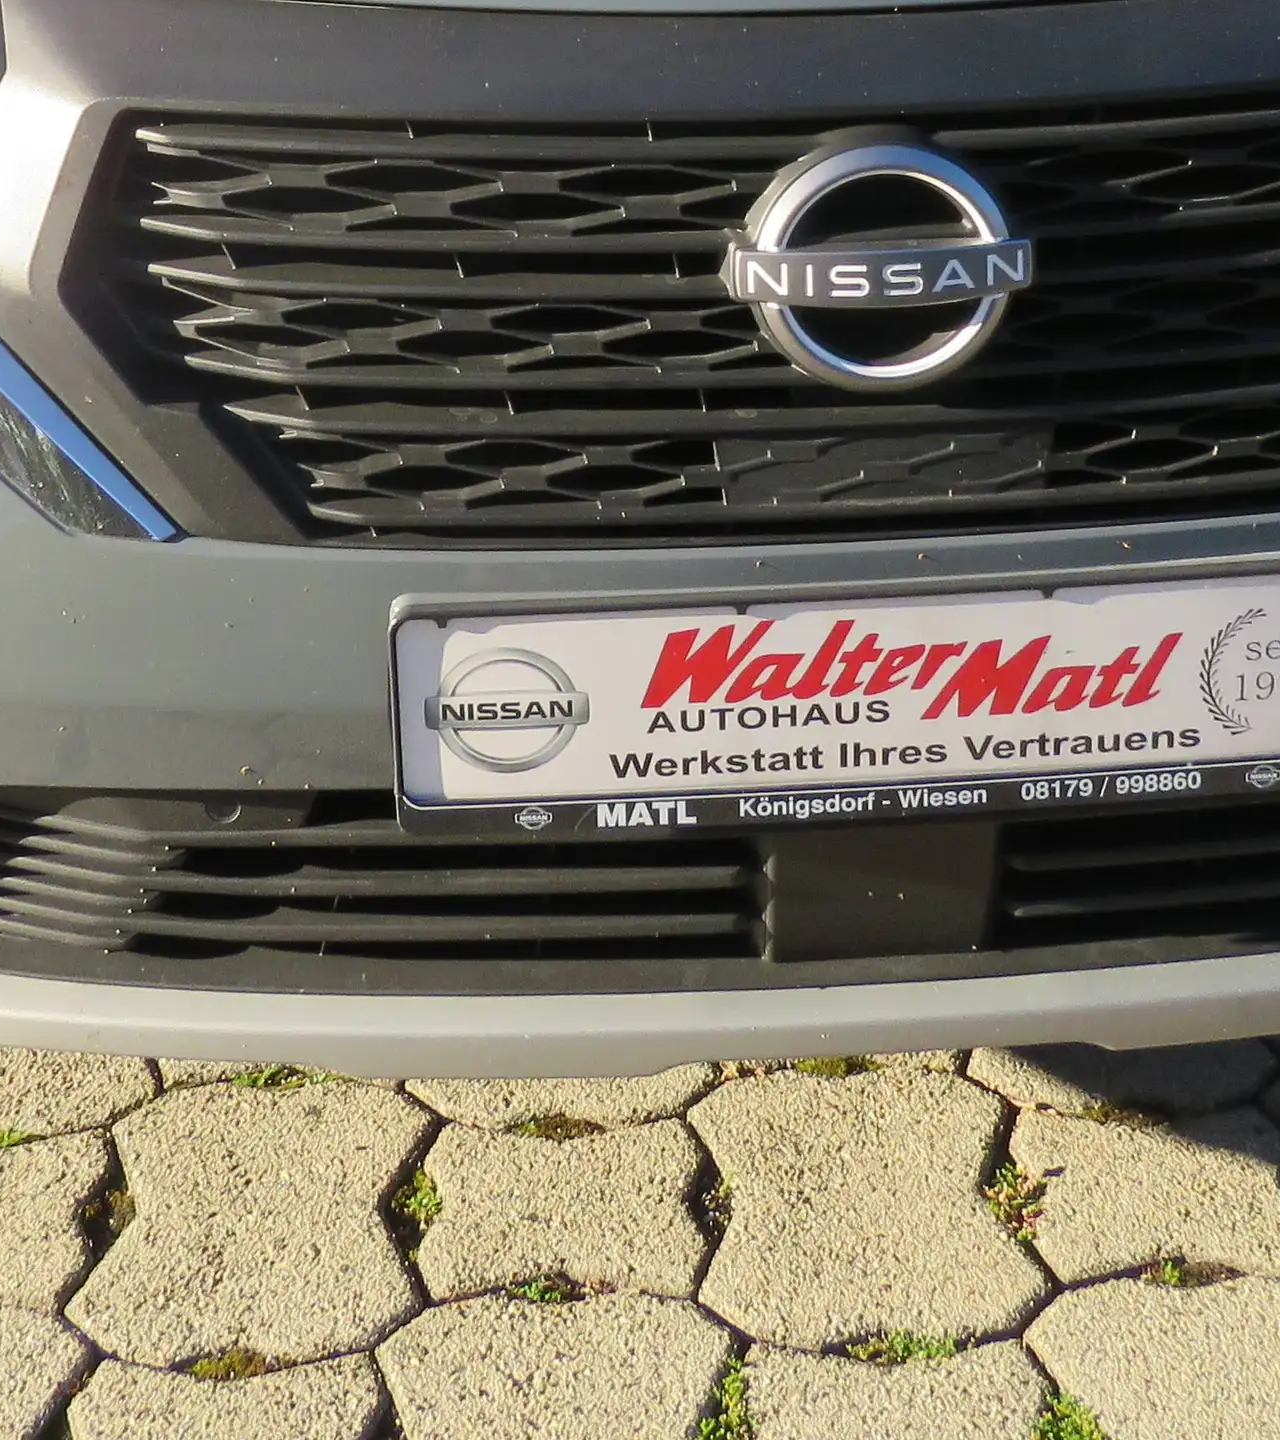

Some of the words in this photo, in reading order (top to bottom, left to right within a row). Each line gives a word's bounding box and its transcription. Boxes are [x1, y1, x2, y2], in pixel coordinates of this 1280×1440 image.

[746, 248, 1025, 298] NISSAN
[640, 619, 968, 709] Walter
[920, 632, 1183, 720] Matl
[440, 699, 574, 722] NISSAN
[646, 700, 891, 735] AUTOHAUS
[609, 744, 824, 779] Werkstatt
[839, 741, 948, 768] Ihres
[963, 726, 1202, 761] Vertrauens
[739, 791, 875, 820] Königsdorf
[897, 787, 987, 809] Wiesen
[1020, 777, 1093, 802] 08179
[1116, 771, 1202, 795] 998860
[596, 799, 697, 828] MATL
